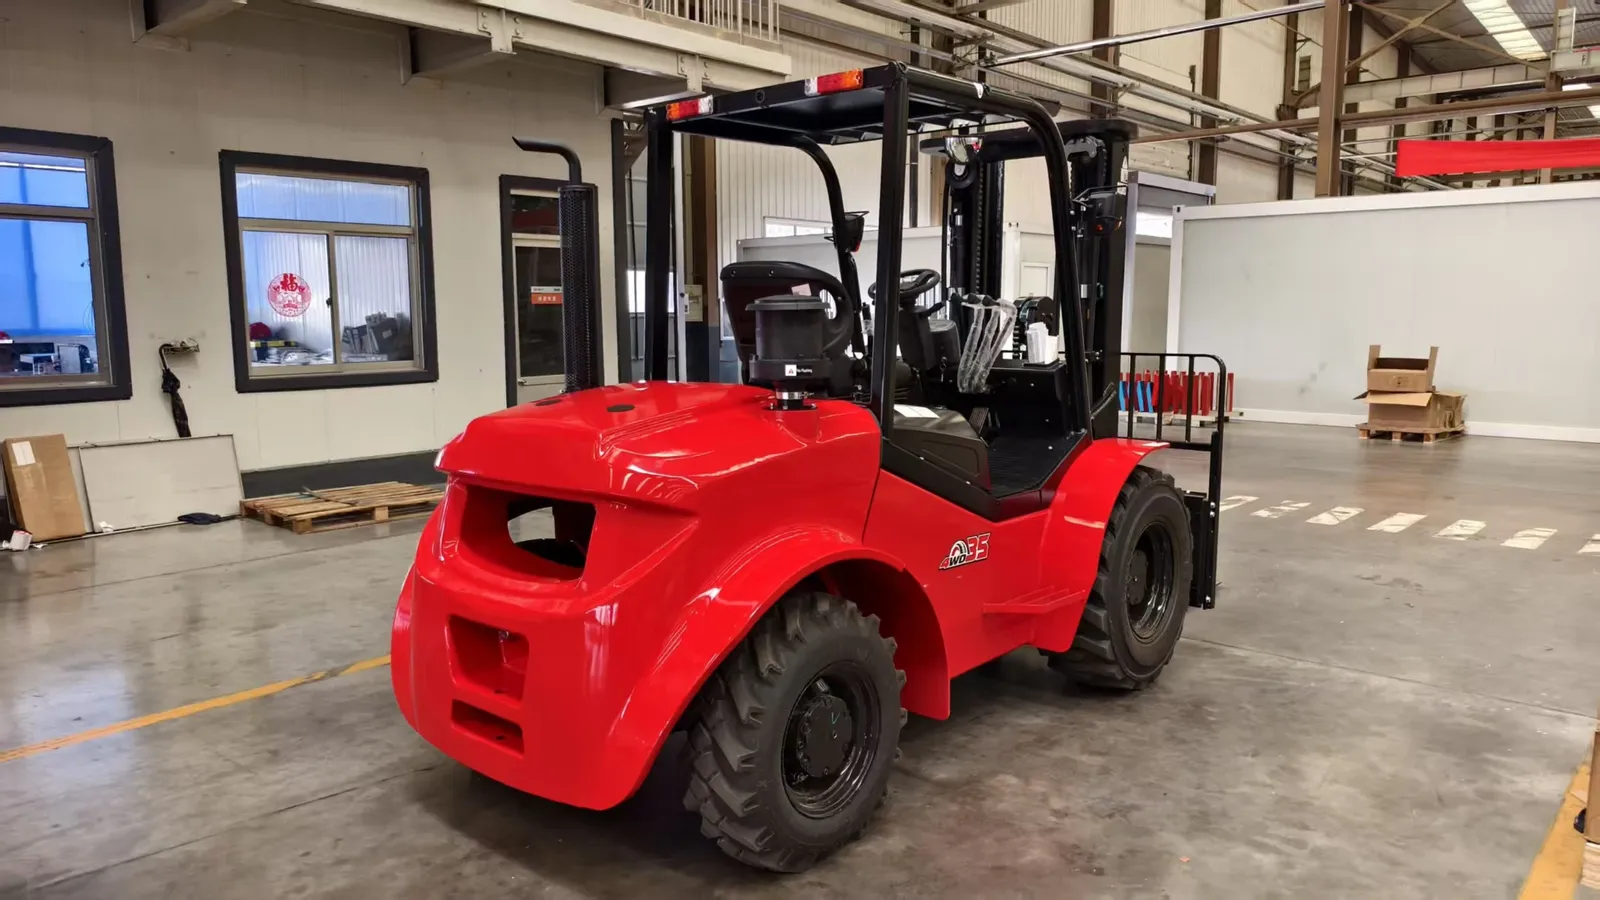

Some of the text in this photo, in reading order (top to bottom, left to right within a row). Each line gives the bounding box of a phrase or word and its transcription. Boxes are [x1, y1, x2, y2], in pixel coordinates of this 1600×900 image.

[280, 273, 298, 291] 福
[939, 533, 990, 569] 4WD 35
